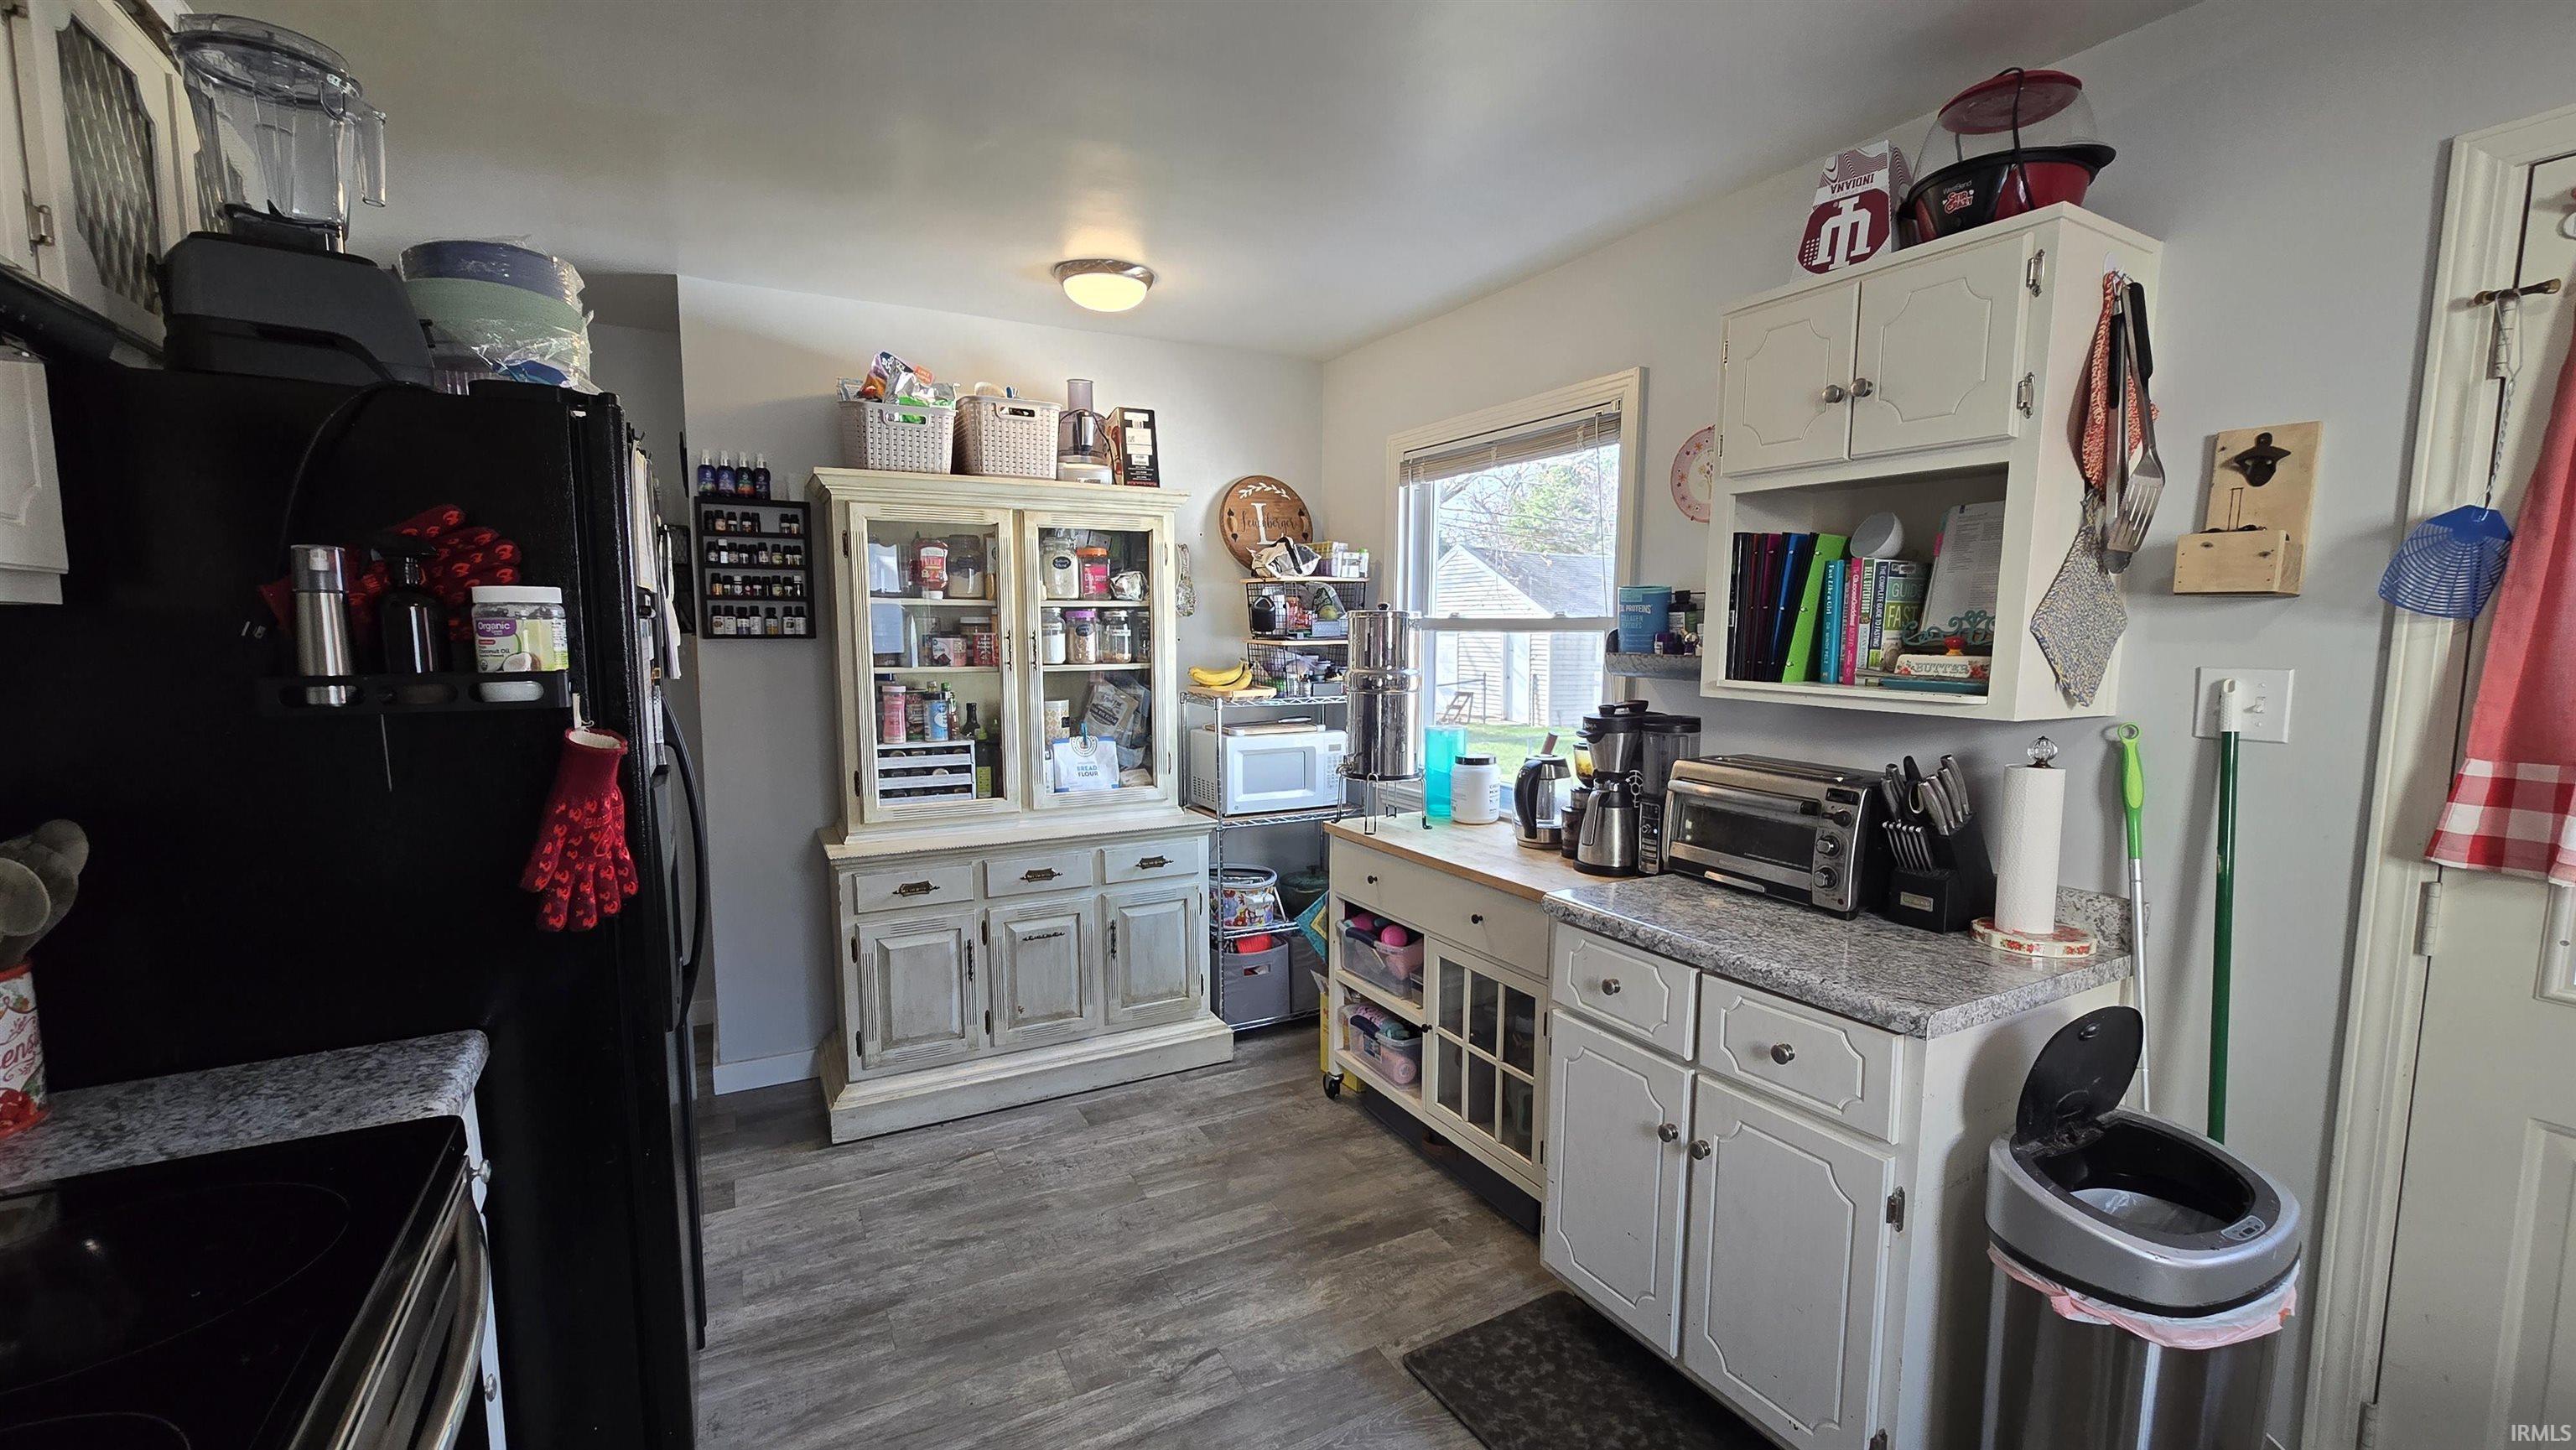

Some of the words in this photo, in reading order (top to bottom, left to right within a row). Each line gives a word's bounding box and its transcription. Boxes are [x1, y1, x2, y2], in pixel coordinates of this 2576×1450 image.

[1831, 174, 1875, 194] INDIANA
[1251, 503, 1277, 545] L
[1863, 565, 1873, 579] REAL
[1861, 579, 1872, 614] SUPERFOODS
[1877, 575, 1886, 602] COMPLETE
[1892, 582, 1924, 598] GUIDE
[1625, 604, 1651, 615] PROTEINS
[1875, 603, 1883, 618] GUIDE
[478, 621, 511, 632] Organic
[1872, 626, 1881, 647] FASTING
[1914, 662, 1970, 674] BUTTER
